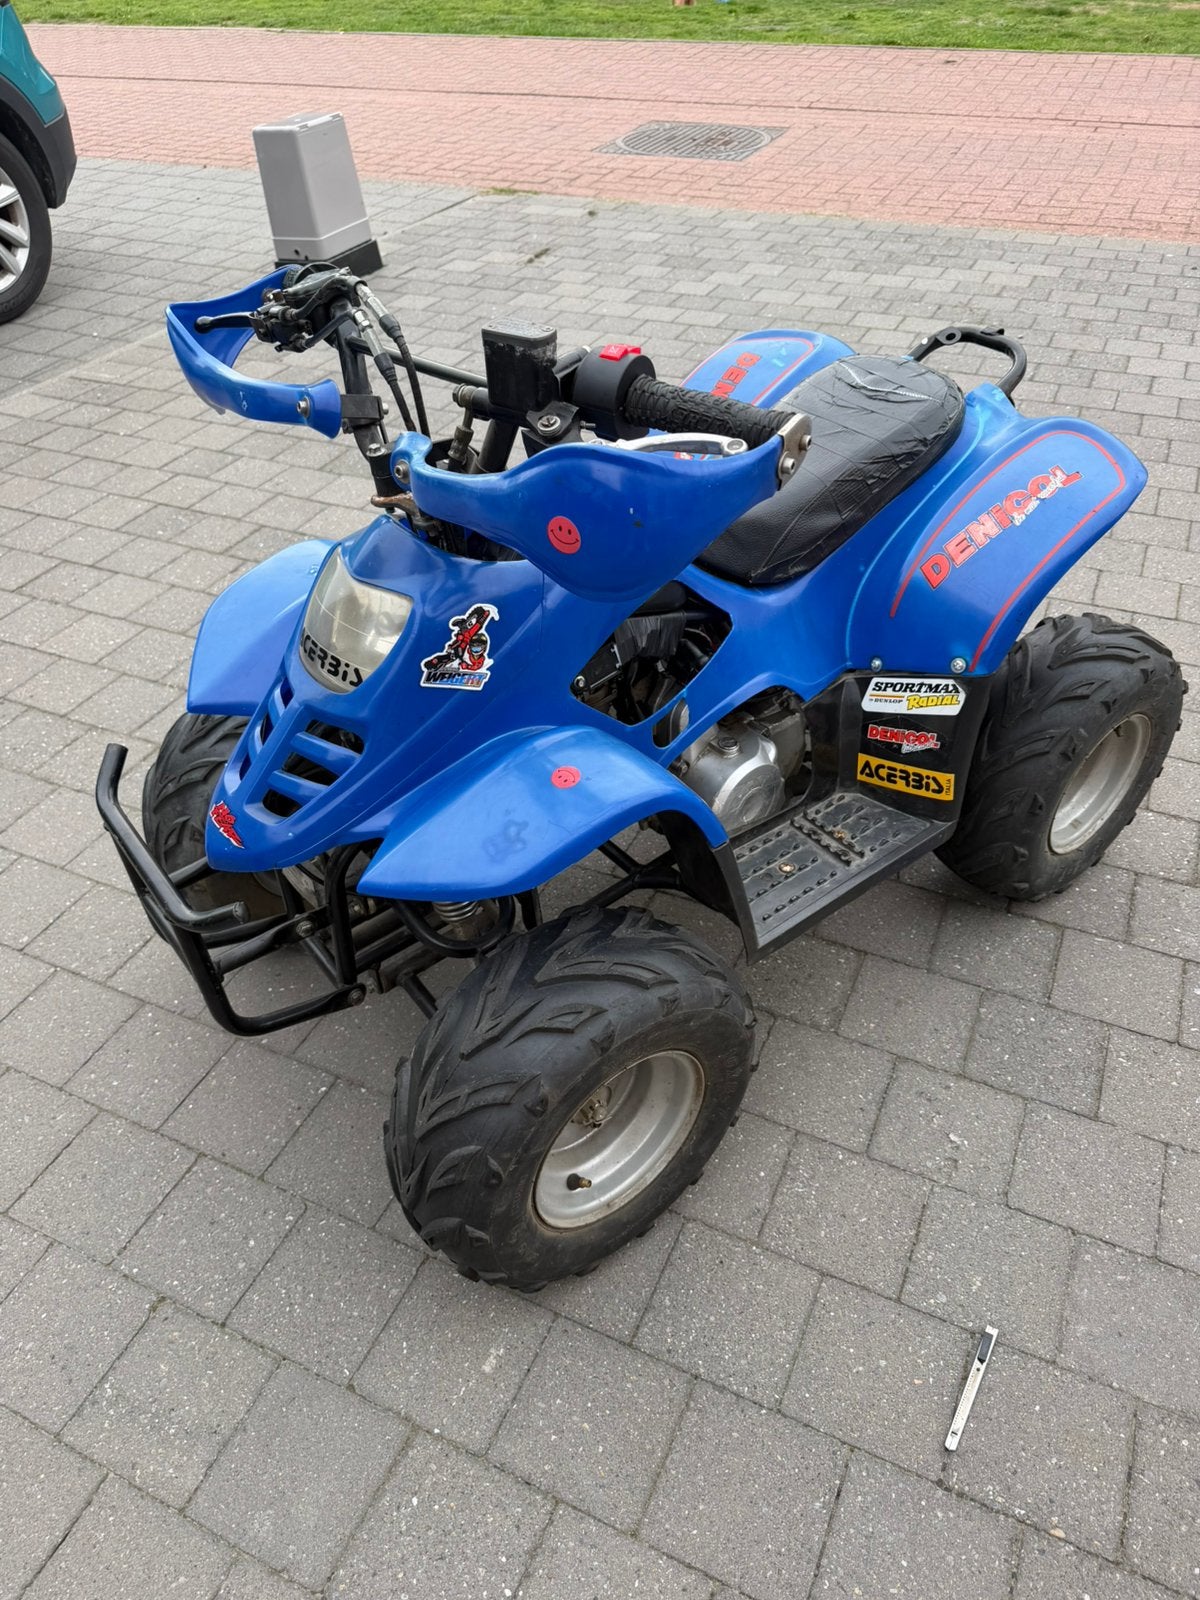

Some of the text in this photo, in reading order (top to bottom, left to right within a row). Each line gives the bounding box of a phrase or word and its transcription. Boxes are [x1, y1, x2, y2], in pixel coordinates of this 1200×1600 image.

[920, 465, 1083, 589] DENICOL
[302, 627, 364, 687] CERBIS
[872, 682, 960, 694] SPORTMAX
[867, 724, 941, 749] DENICOL
[860, 760, 944, 794] ACERBIS
